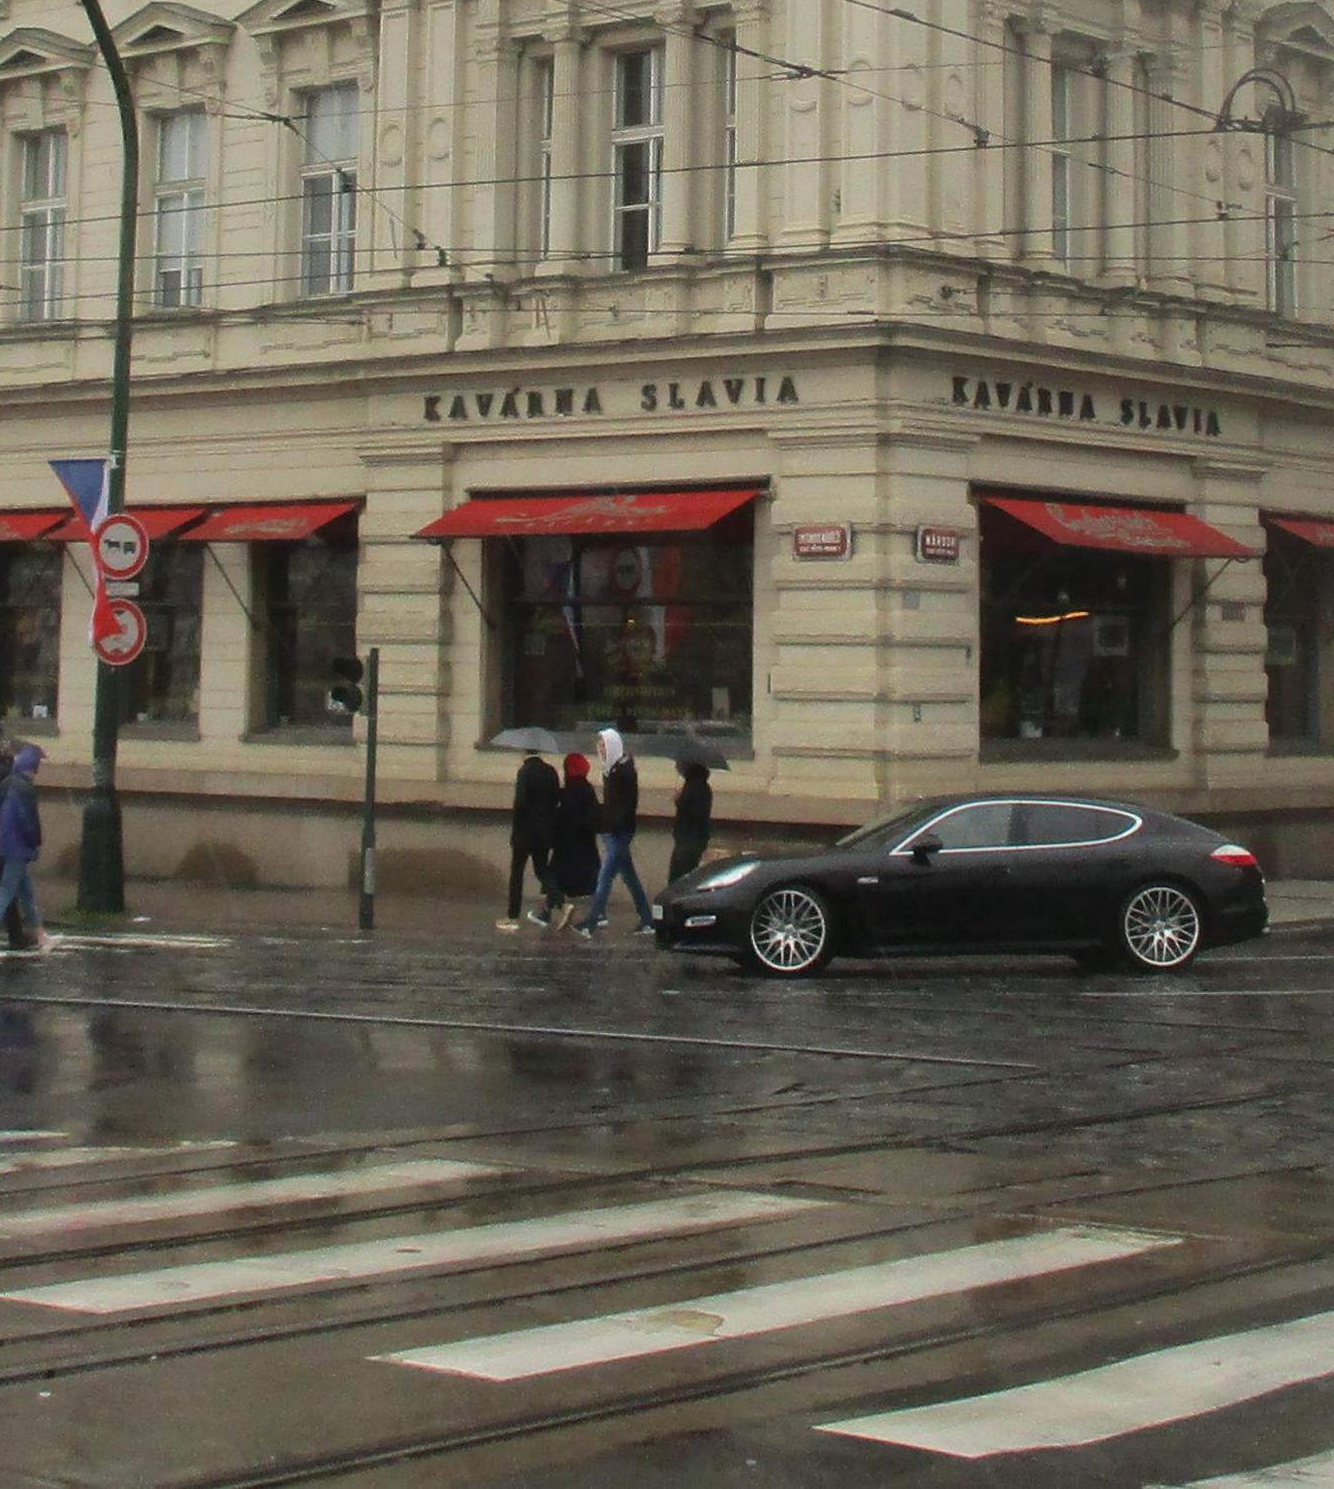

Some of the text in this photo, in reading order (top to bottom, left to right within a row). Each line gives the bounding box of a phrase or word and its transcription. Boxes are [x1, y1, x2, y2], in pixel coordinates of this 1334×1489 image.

[422, 375, 800, 422] KAVÁRNA SLAVIA
[951, 376, 1222, 437] KAVÁRNA SLAVIA
